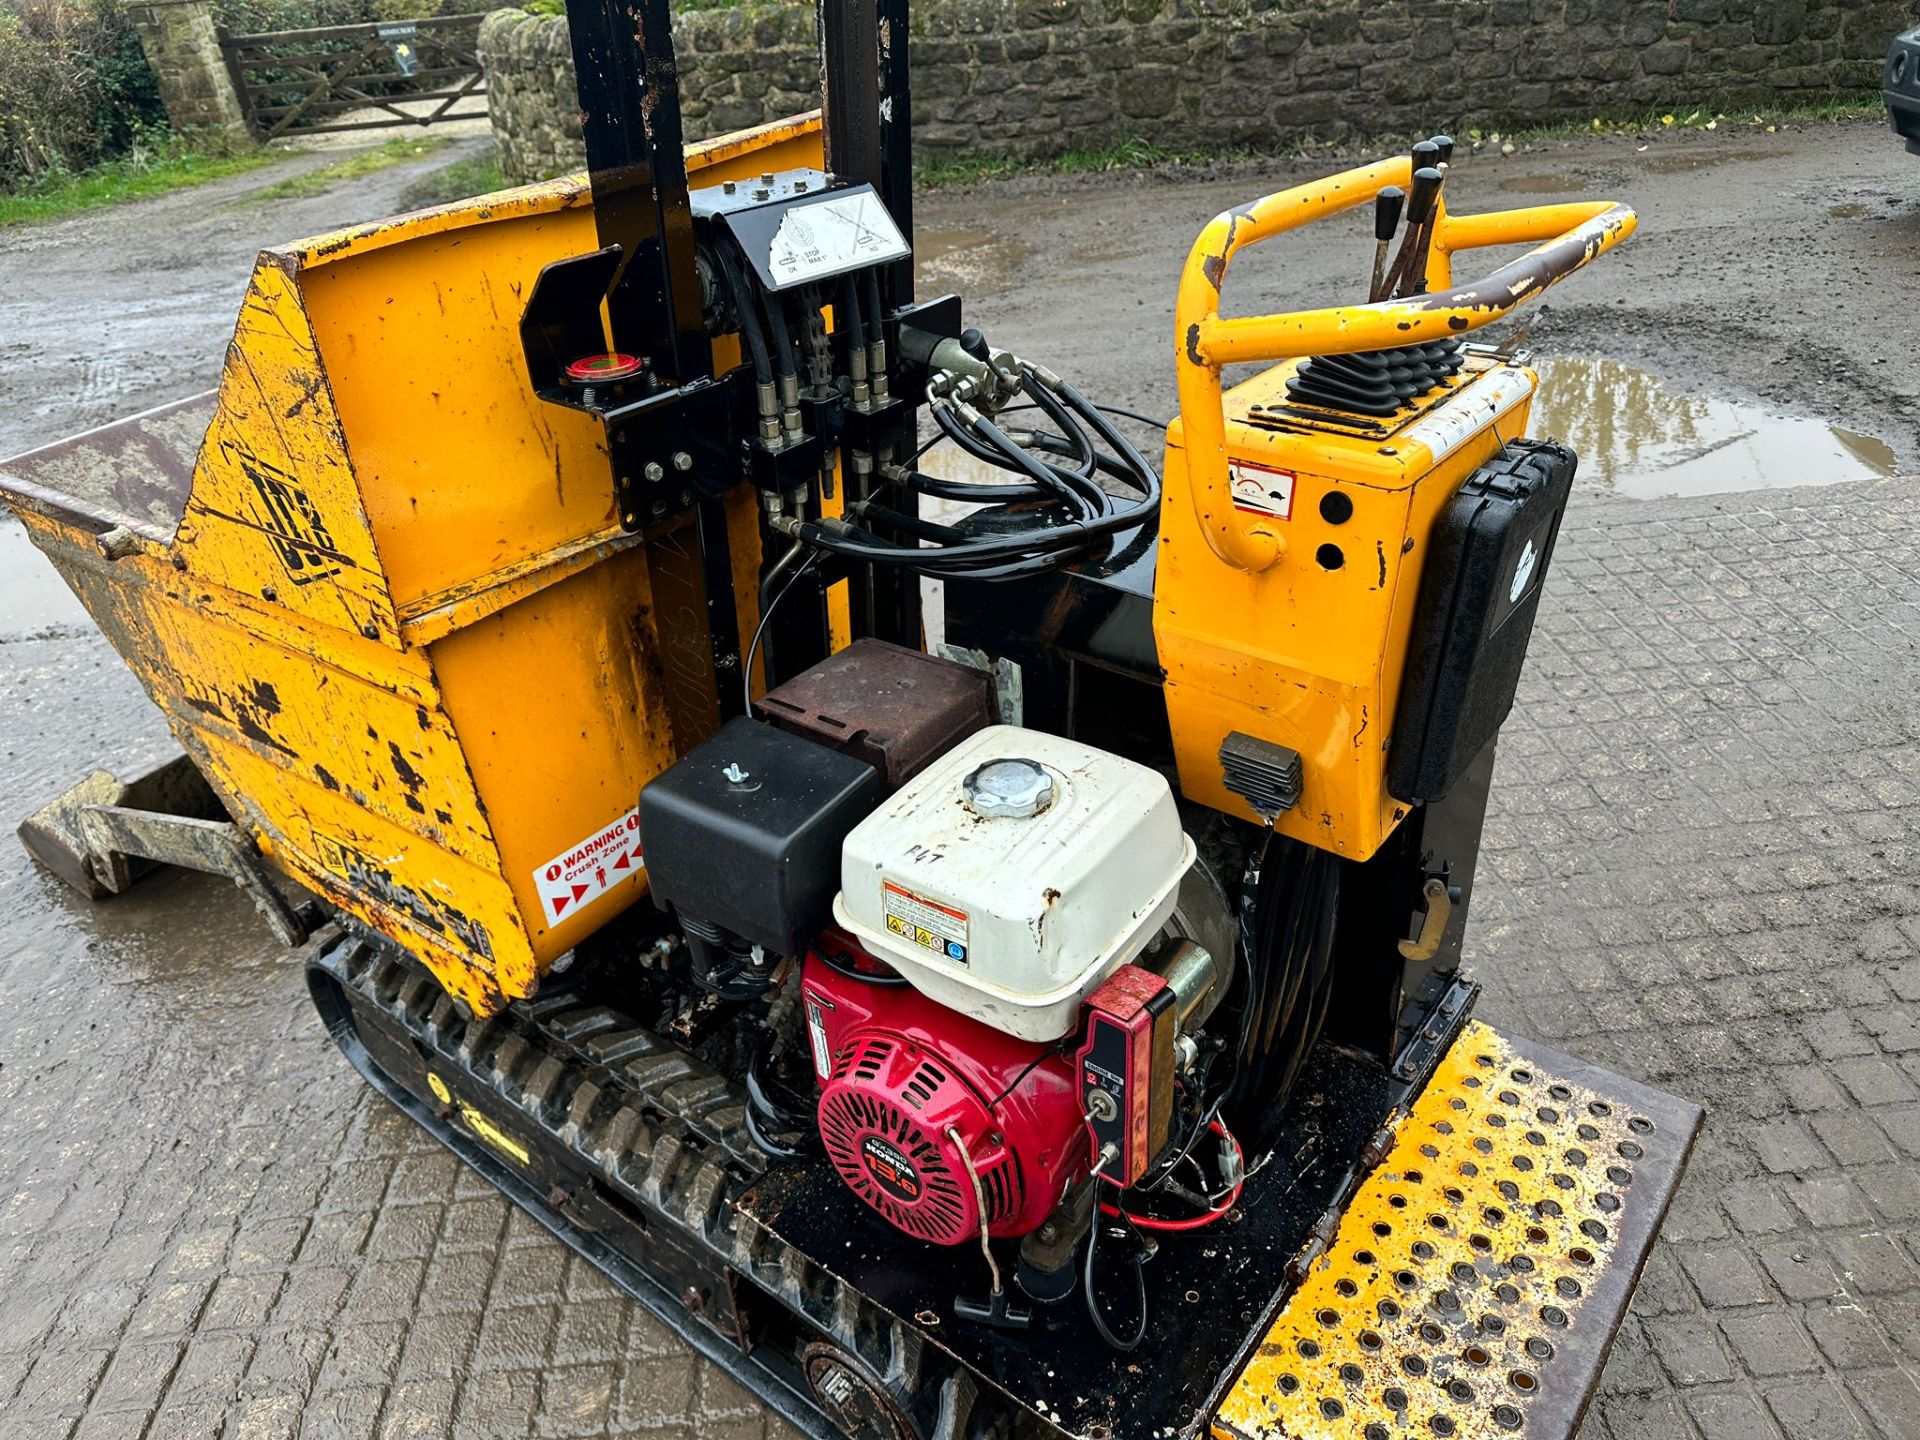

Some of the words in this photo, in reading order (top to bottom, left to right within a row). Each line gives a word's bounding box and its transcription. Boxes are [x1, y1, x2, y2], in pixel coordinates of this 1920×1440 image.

[563, 824, 625, 869] WARNING
[564, 857, 599, 882] Crush
[601, 837, 630, 858] Zone
[865, 1142, 915, 1178] HONDA
